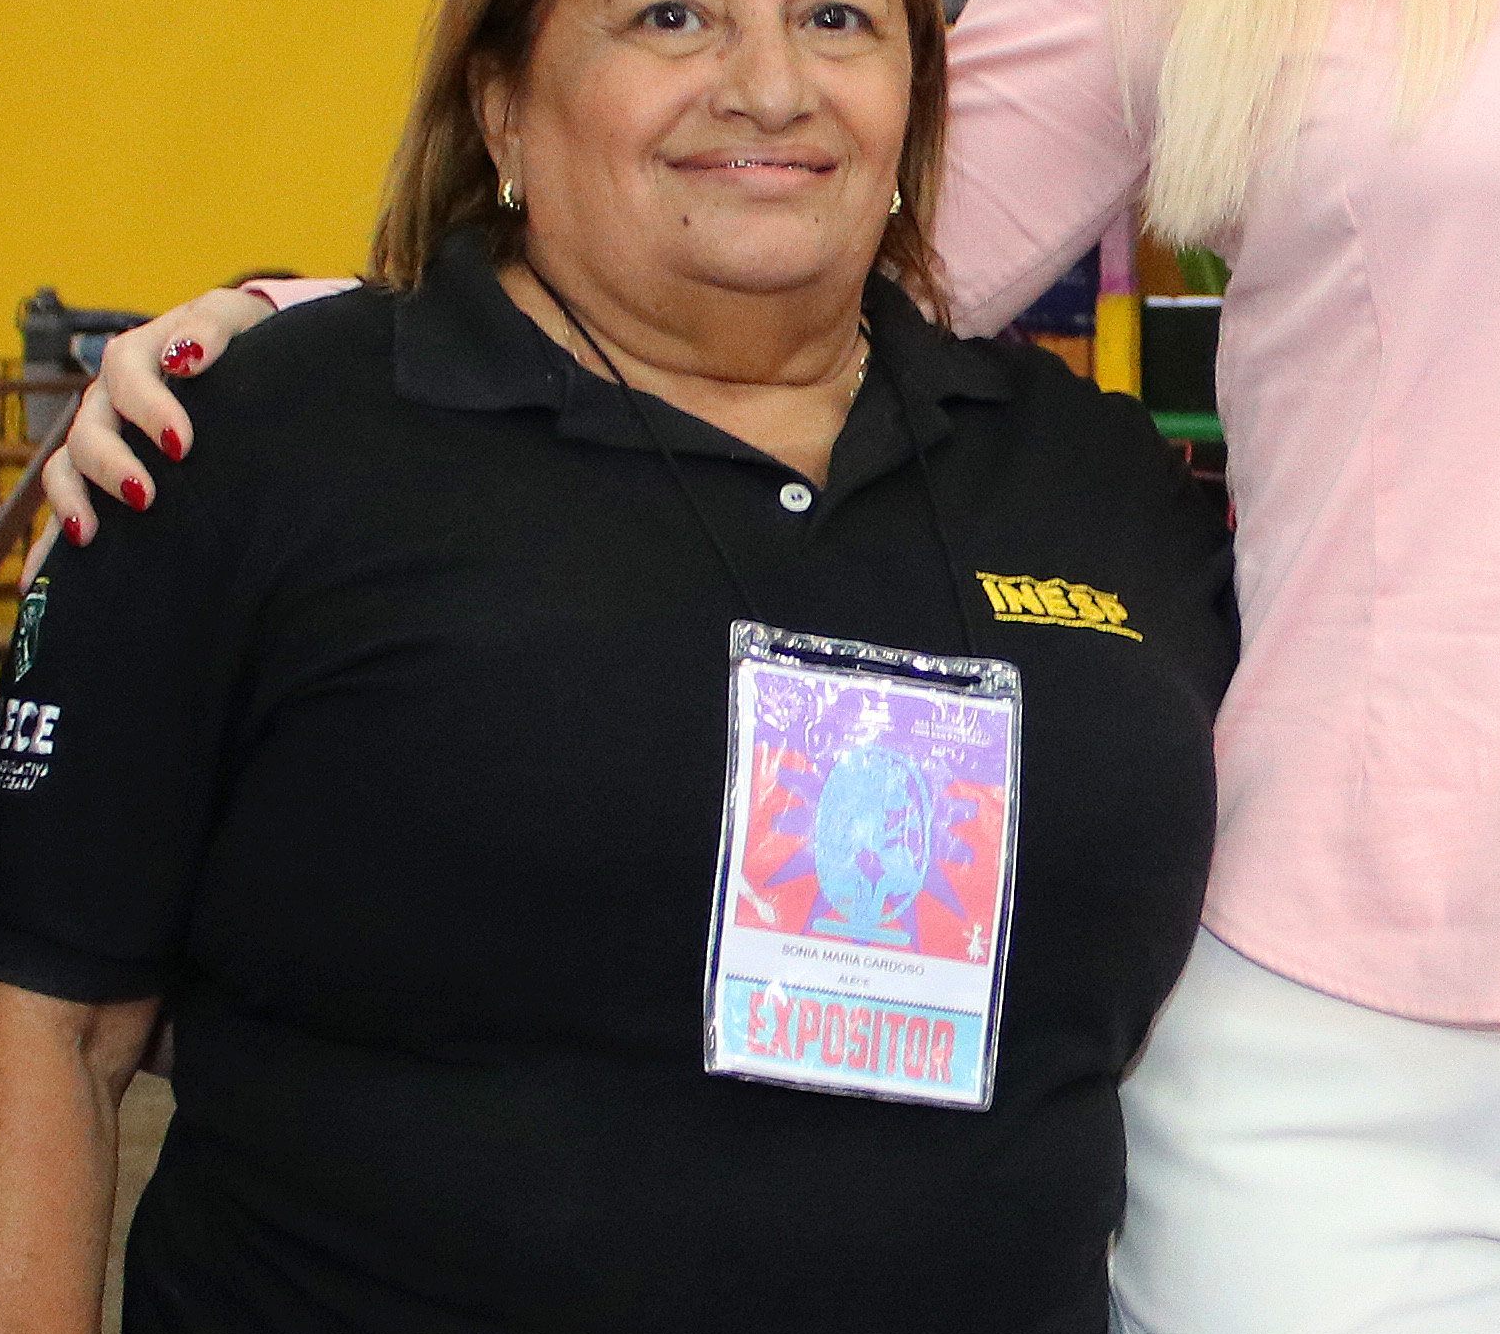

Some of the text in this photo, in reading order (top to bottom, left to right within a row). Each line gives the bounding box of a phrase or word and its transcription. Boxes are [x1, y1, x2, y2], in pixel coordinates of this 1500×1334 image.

[980, 575, 1130, 629] INESP
[822, 949, 861, 968] MARIA
[863, 956, 925, 977] CARDOSO
[747, 990, 956, 1084] EXPOSITOR
